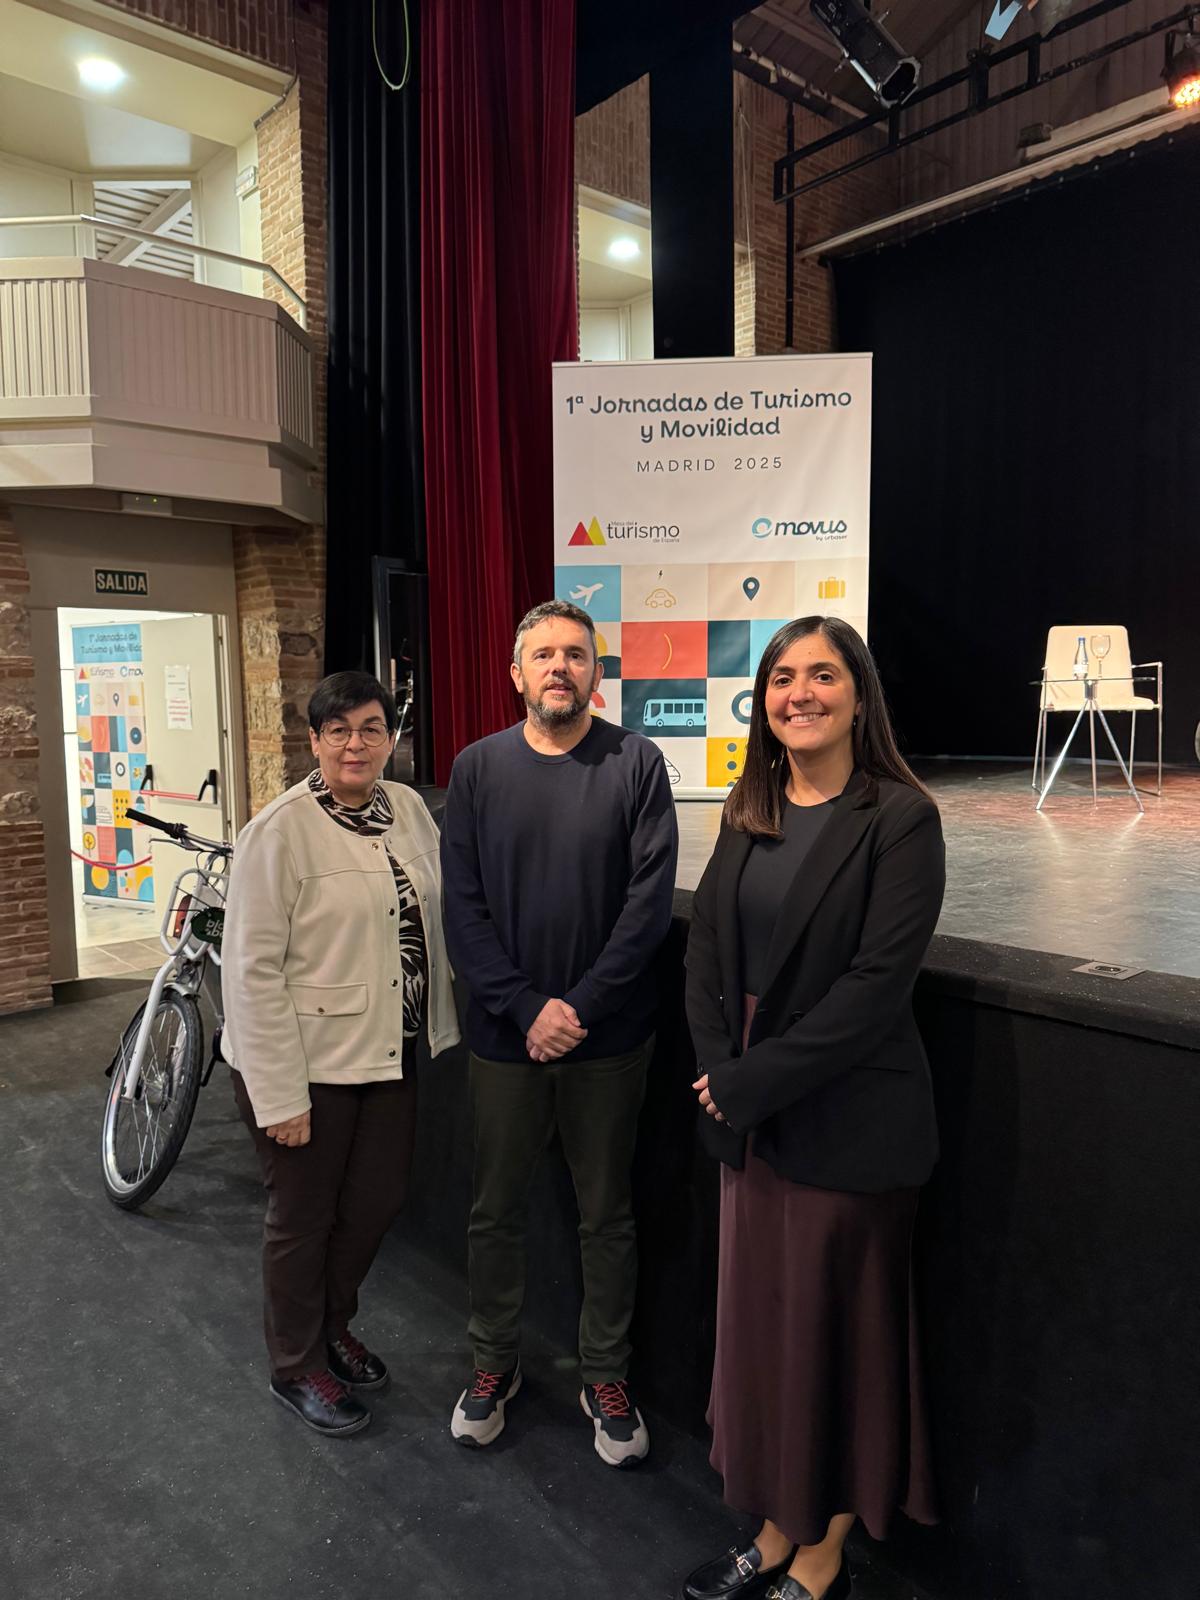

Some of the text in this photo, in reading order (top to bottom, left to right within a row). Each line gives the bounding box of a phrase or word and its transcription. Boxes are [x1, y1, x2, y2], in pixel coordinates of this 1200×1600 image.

[566, 388, 852, 414] 1ª Jornadas de Turismo
[640, 416, 780, 443] y Movilidad
[637, 457, 782, 472] MADRID 2025
[607, 522, 680, 539] turismo
[774, 520, 847, 536] movus
[96, 573, 147, 592] SALIDA
